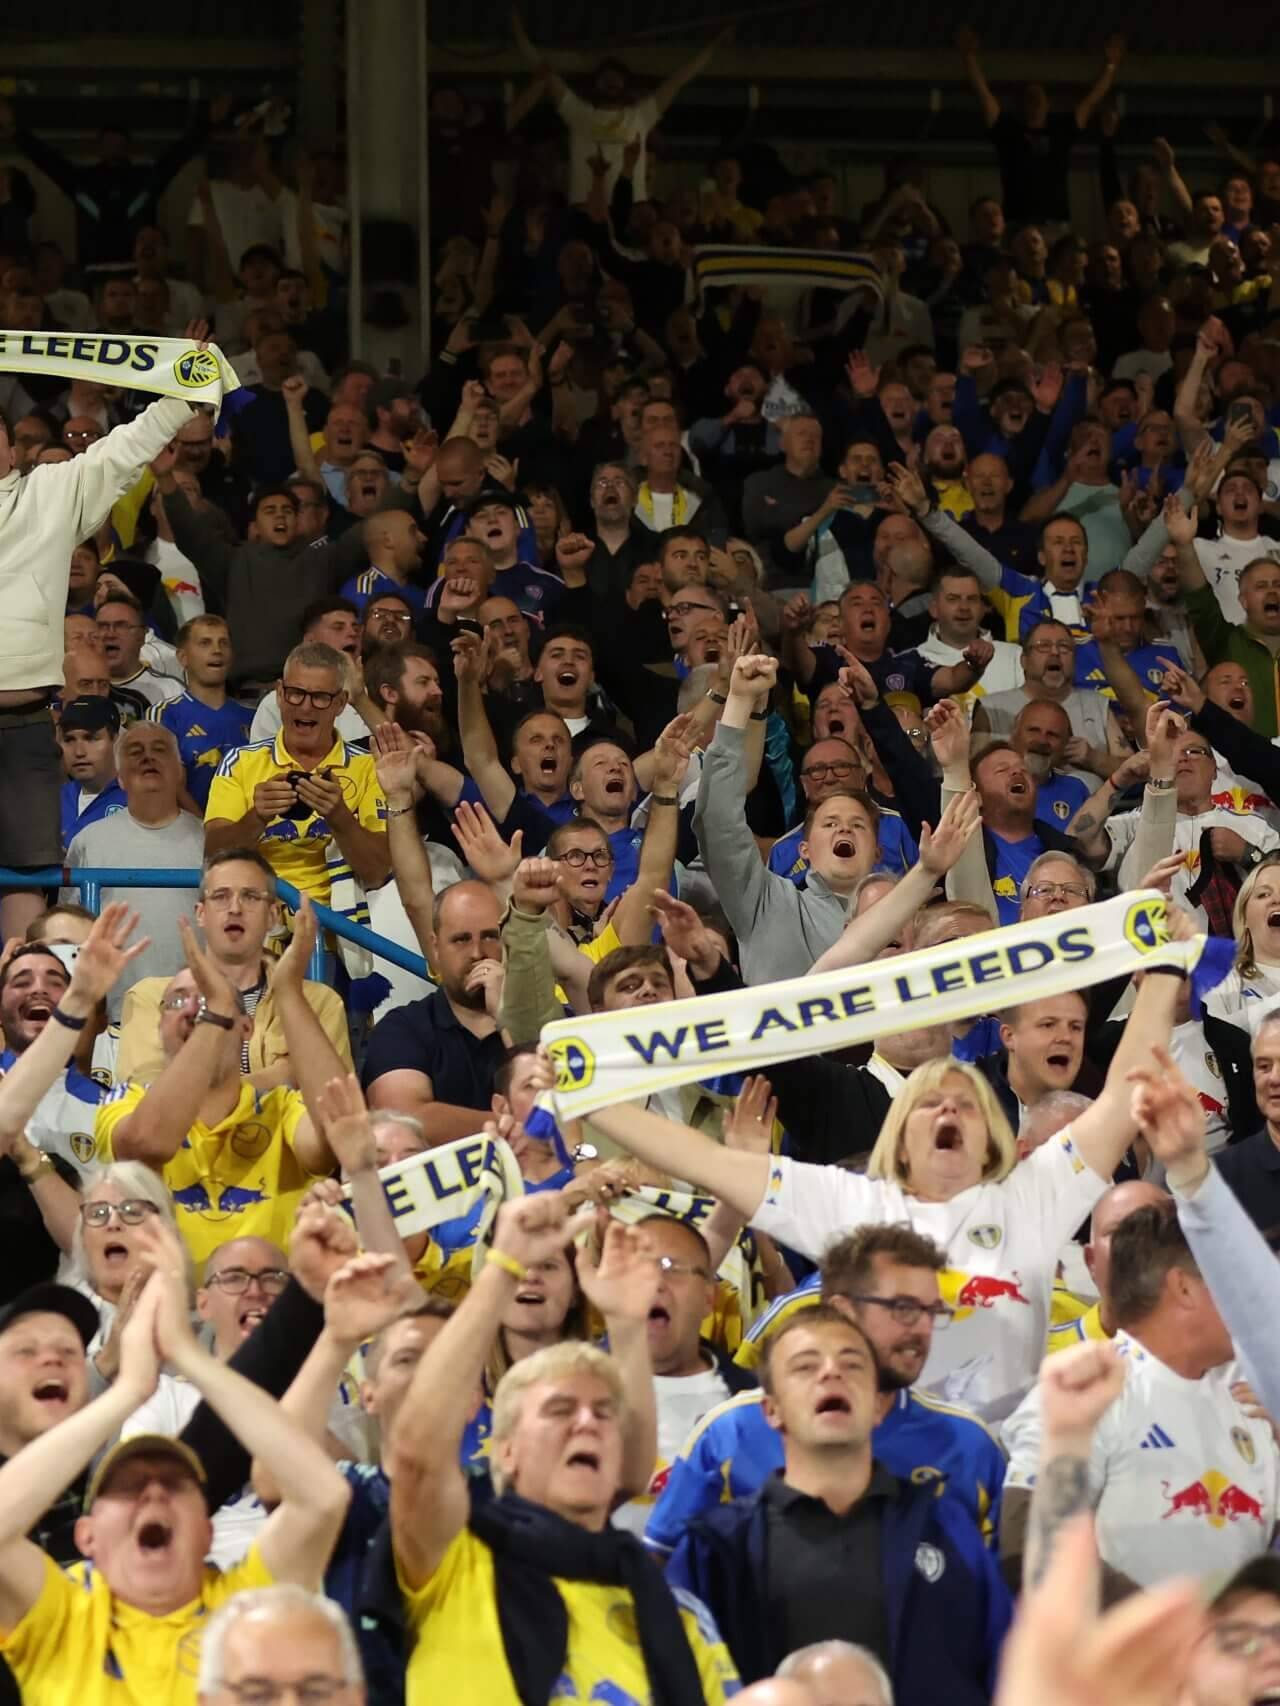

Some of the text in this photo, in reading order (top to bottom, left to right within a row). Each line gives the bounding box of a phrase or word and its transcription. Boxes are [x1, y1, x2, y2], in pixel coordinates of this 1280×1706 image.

[21, 335, 160, 371] LEEDS
[625, 927, 1096, 1064] WE ARE LEEDS
